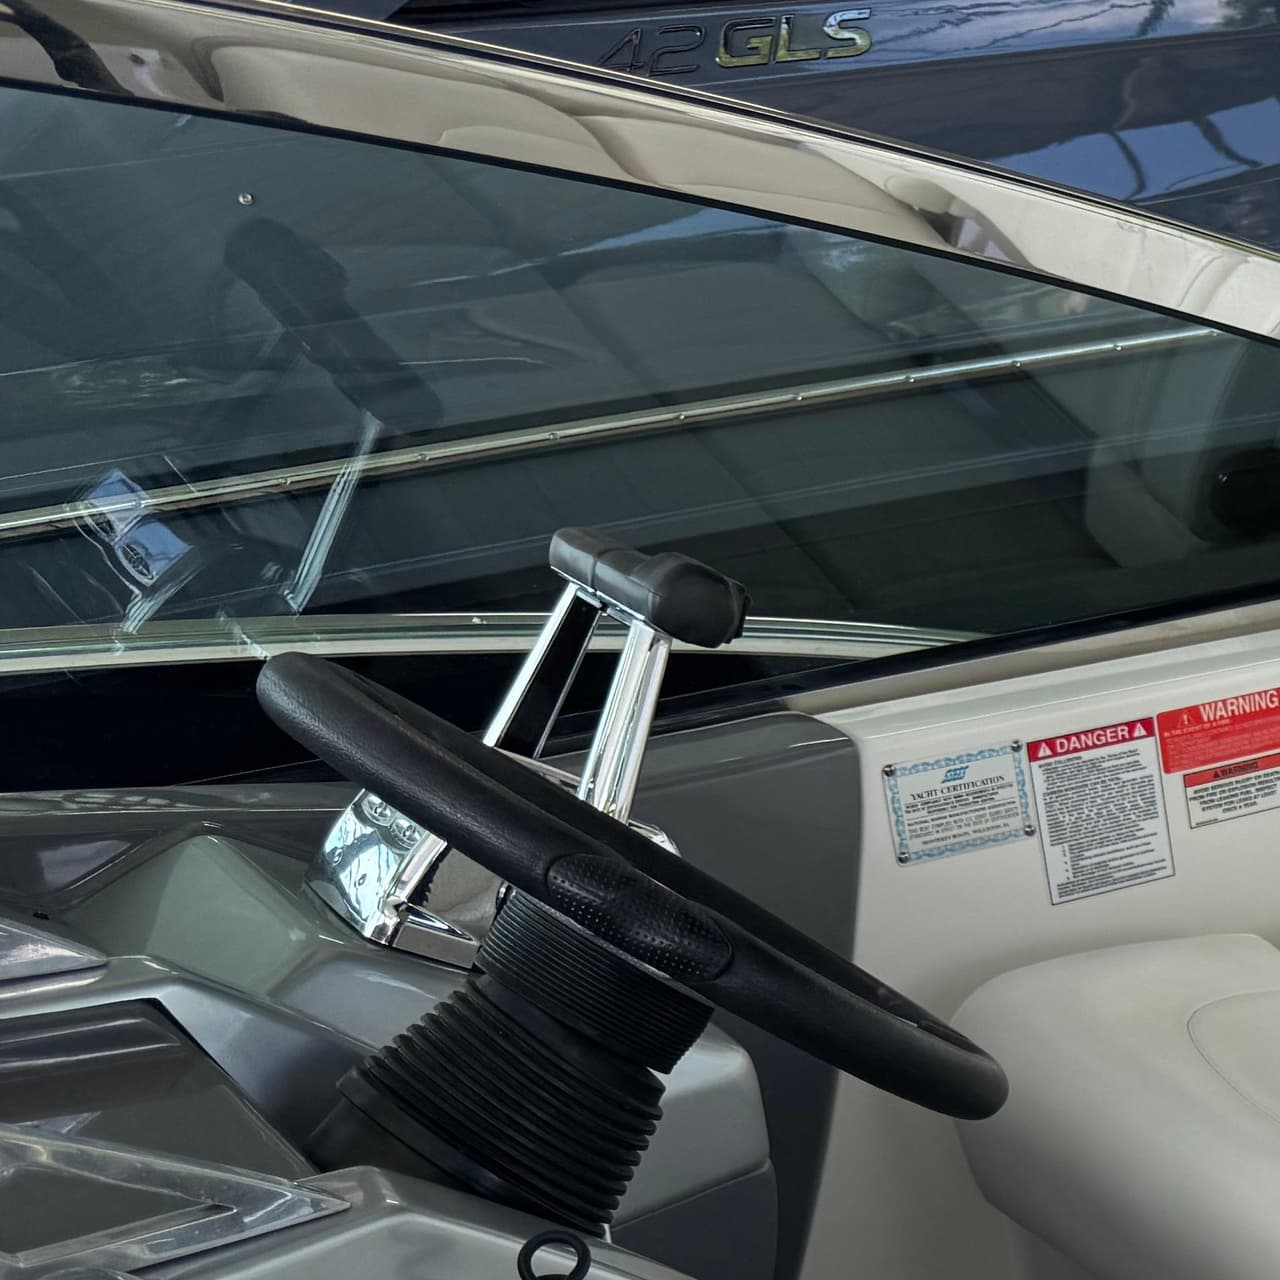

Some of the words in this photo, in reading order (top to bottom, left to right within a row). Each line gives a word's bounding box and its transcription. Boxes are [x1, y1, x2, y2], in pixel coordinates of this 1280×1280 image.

[598, 25, 706, 76] 42
[715, 8, 872, 68] GLS
[1200, 690, 1279, 722] WARNING
[1055, 726, 1129, 753] DANGER
[910, 787, 938, 801] YACHT
[940, 774, 1005, 795] CERTIFICATION
